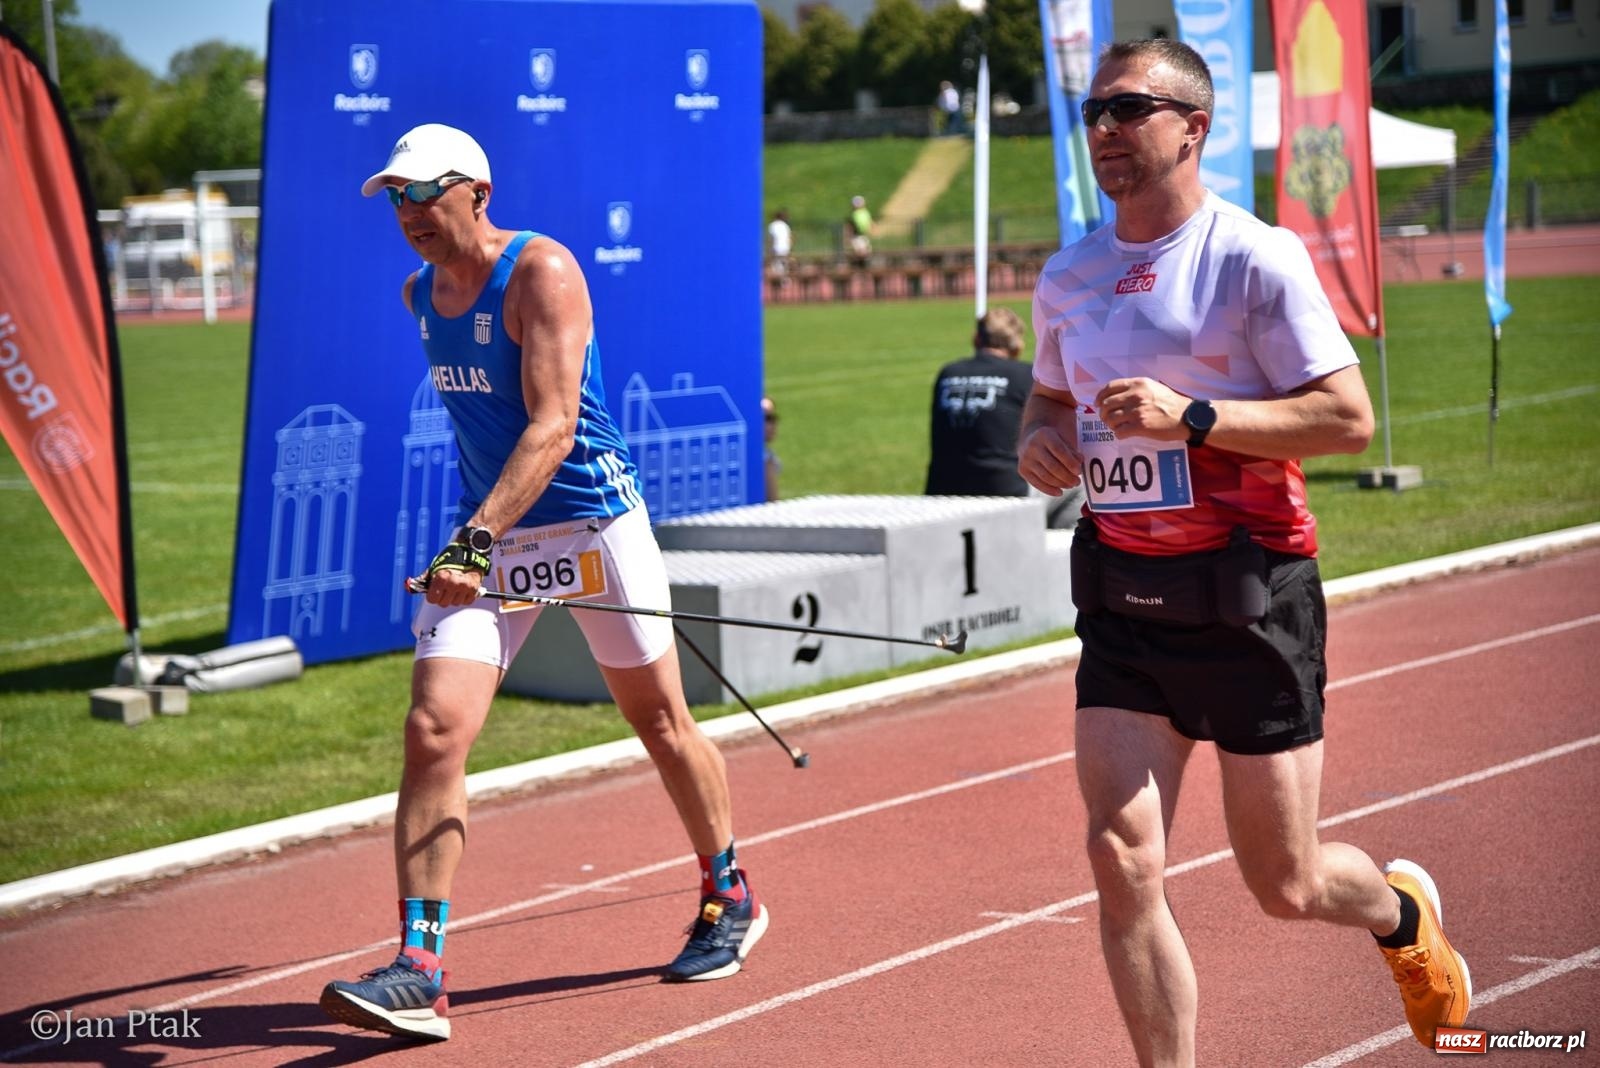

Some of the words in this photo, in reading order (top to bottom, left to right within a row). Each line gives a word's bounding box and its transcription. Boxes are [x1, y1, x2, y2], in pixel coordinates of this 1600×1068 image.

[1118, 276, 1155, 293] HERO
[1126, 261, 1156, 276] JUST
[431, 365, 492, 393] HELLAS
[1089, 455, 1154, 494] 040
[509, 557, 575, 595] 096
[960, 528, 979, 597] 1
[791, 590, 824, 667] 2
[412, 919, 446, 937] RU
